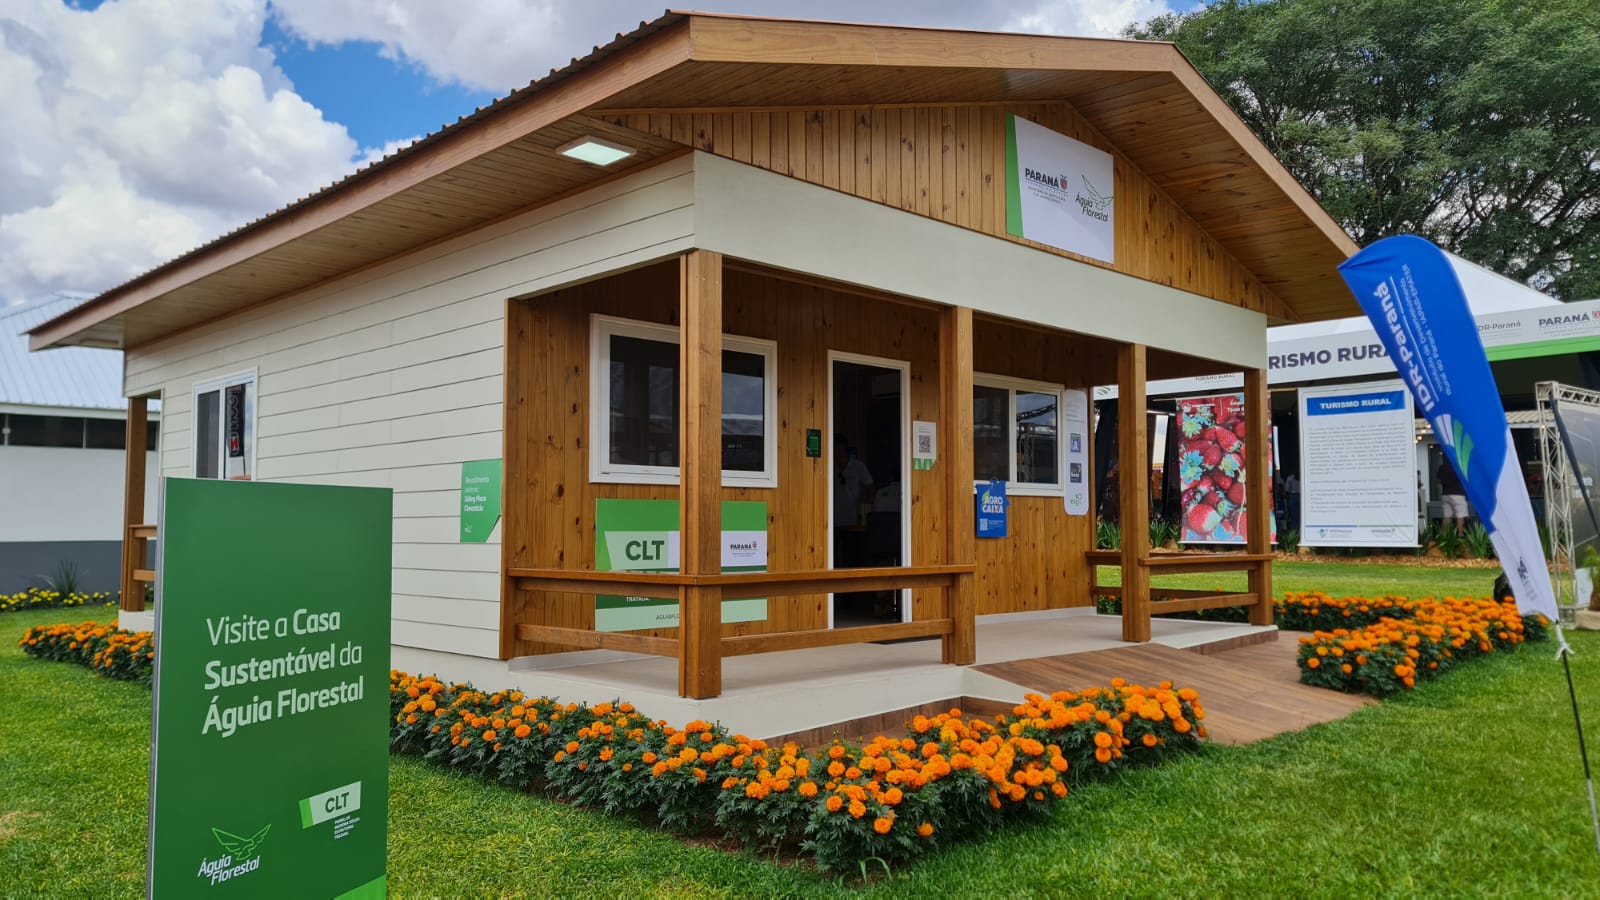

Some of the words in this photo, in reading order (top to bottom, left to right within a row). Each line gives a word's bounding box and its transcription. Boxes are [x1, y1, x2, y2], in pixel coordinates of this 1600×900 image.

[1025, 167, 1059, 188] PARANÁ
[1075, 192, 1093, 208] Águia
[1082, 206, 1109, 222] Florestal
[1539, 312, 1590, 326] PARANÁ
[1373, 282, 1435, 412] IDR-Paraná
[1320, 400, 1360, 409] TURISMO
[1361, 398, 1392, 407] RURAL
[982, 504, 1004, 513] CAIXA
[983, 496, 1004, 505] AGRO
[625, 540, 665, 561] CLT
[206, 614, 270, 646] Visite
[274, 617, 288, 637] a
[292, 608, 341, 635] Casa
[204, 643, 336, 690] Sustentável
[340, 640, 362, 666] da
[202, 695, 272, 738] Águia
[277, 675, 364, 718] Florestal
[325, 792, 350, 813] CLT
[197, 854, 232, 878] Águia
[211, 855, 260, 886] Florestal
